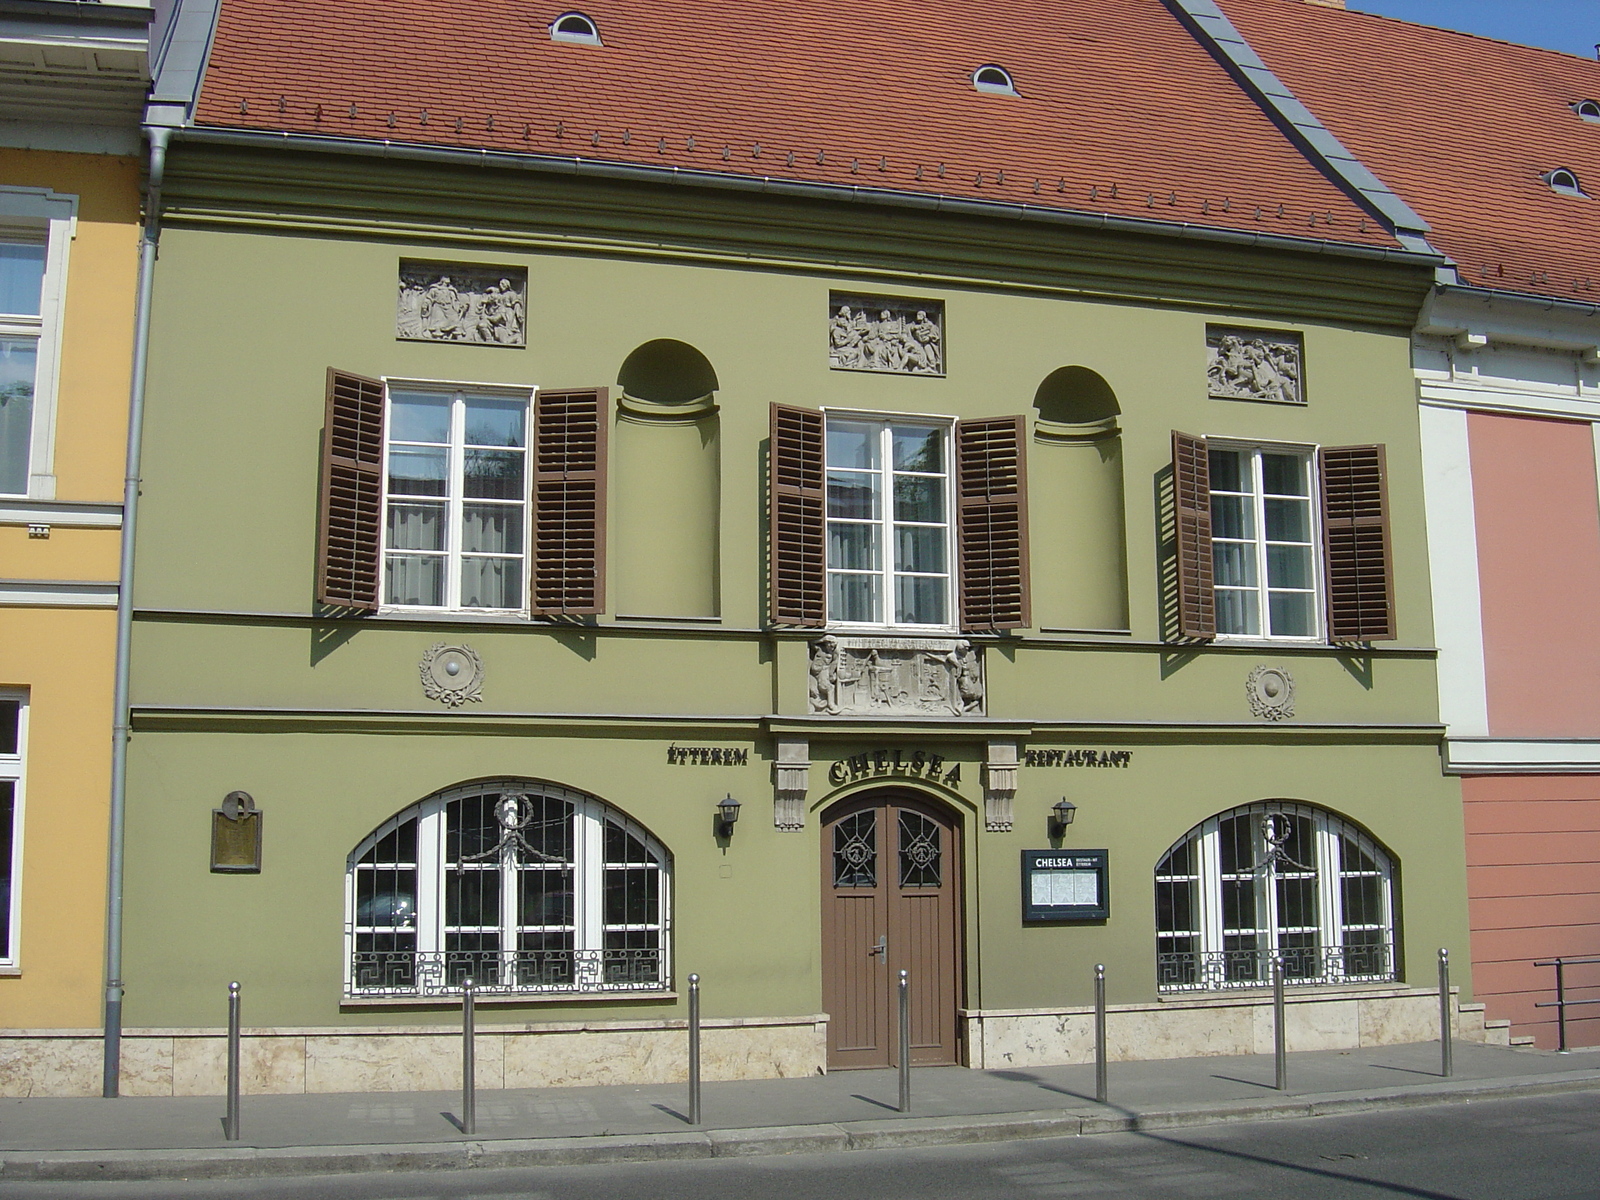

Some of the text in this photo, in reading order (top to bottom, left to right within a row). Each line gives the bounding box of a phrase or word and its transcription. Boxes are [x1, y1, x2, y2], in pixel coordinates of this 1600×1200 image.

[667, 742, 748, 764] ÉTTEREM
[1025, 749, 1133, 766] RESTAURANT
[829, 749, 961, 785] CHELSEA
[1035, 858, 1073, 868] CHELSEA
